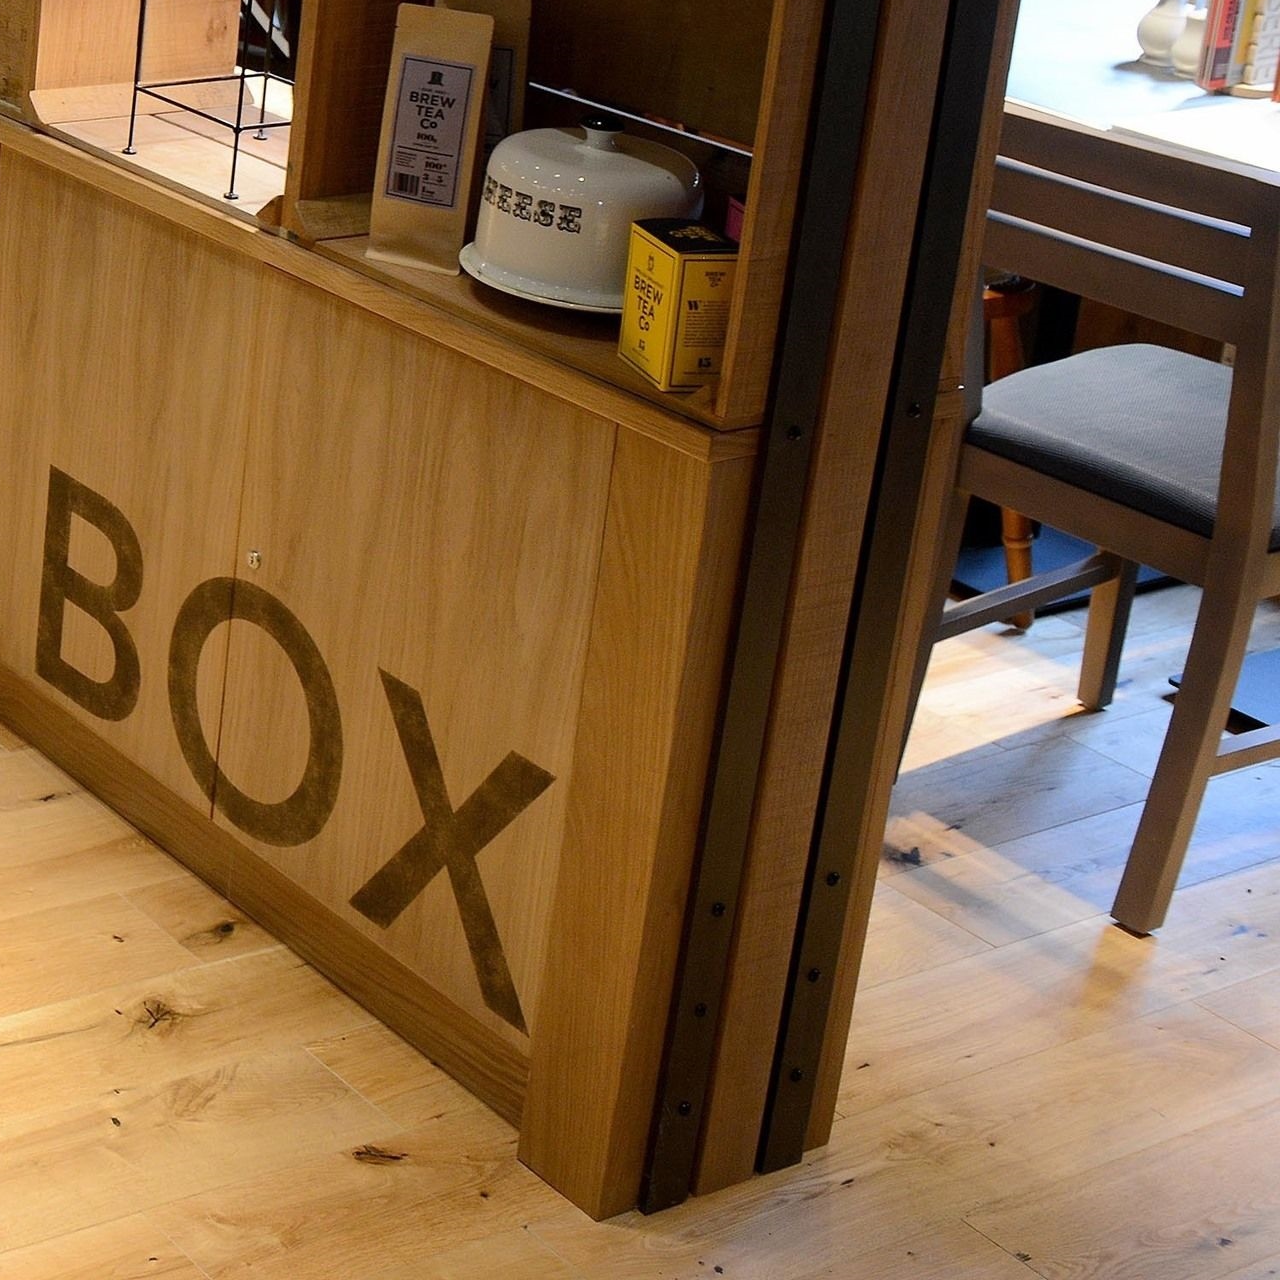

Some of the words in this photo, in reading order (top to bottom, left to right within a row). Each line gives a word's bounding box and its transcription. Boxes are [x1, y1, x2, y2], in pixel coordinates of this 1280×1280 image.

[409, 91, 456, 109] BREW
[416, 105, 445, 120] TEA
[420, 118, 438, 129] Co
[634, 274, 663, 306] BREW
[637, 295, 655, 321] TEA
[639, 315, 649, 332] Co
[36, 465, 557, 1035] BOX
